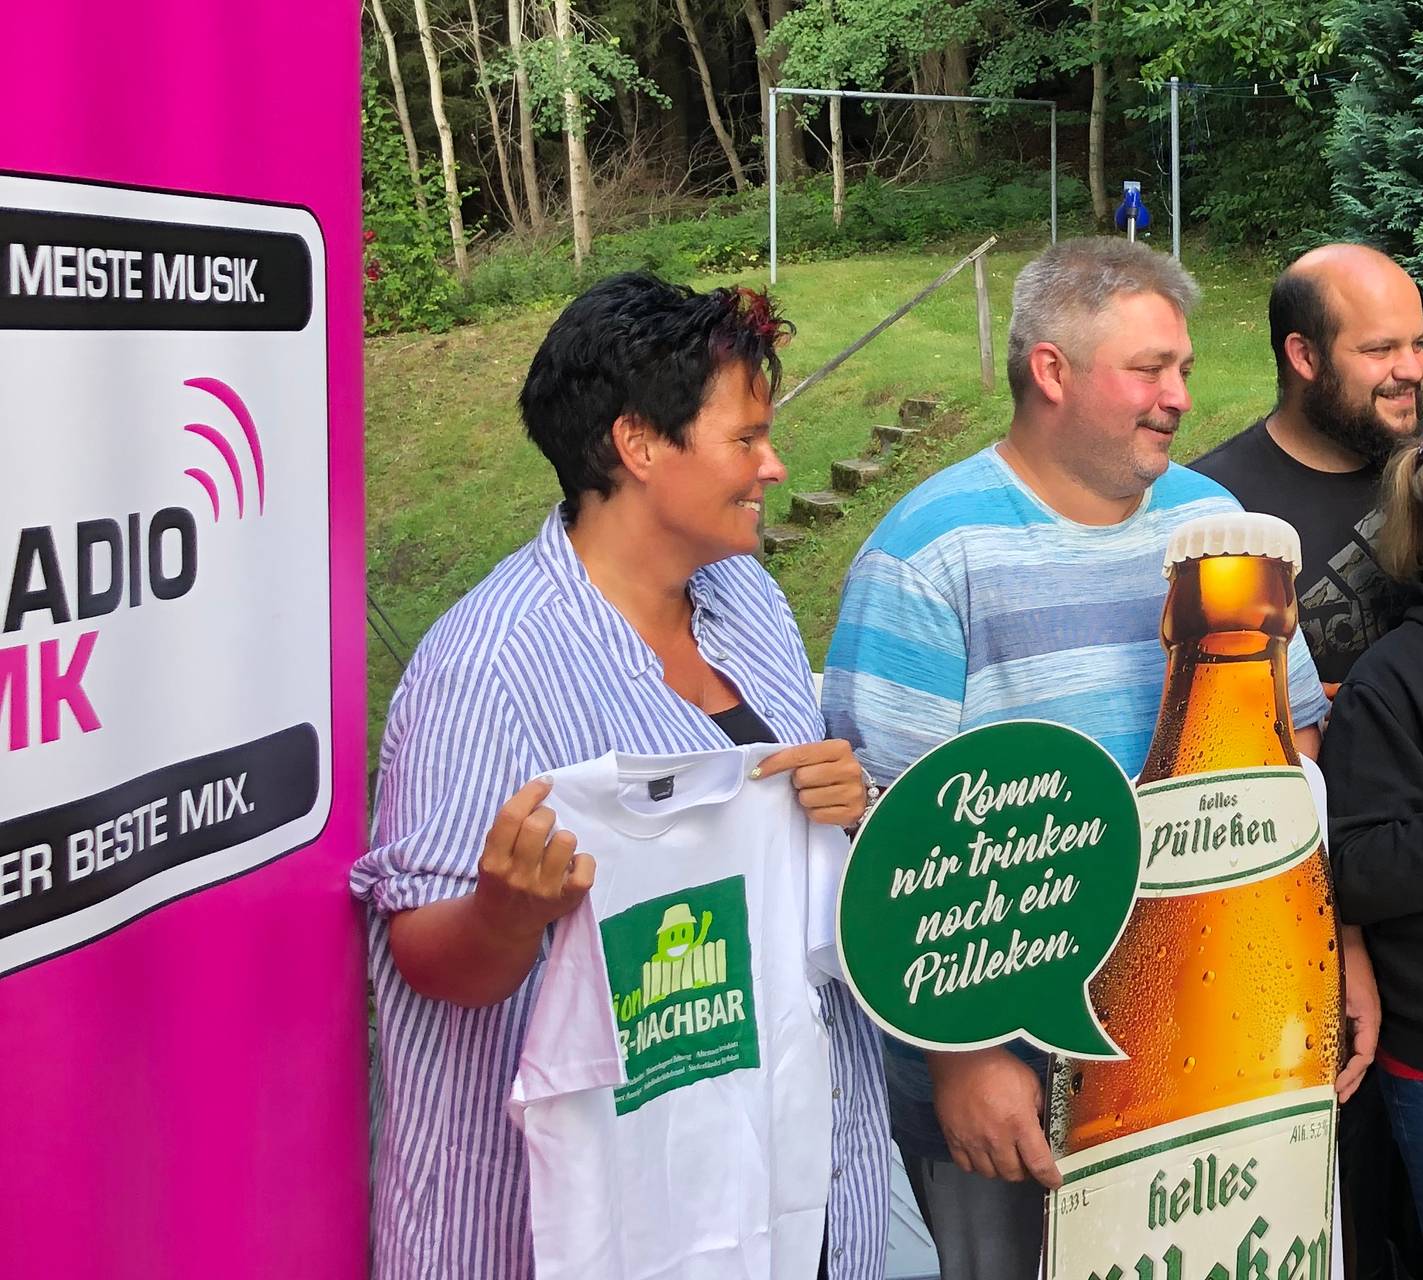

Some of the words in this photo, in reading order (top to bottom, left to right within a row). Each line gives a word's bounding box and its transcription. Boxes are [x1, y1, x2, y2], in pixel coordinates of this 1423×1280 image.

[9, 242, 144, 299] MEISTE
[152, 252, 266, 303] MUSIK.
[937, 768, 1072, 826] Komm,
[1198, 791, 1239, 812] helles
[0, 843, 53, 905] ER
[67, 797, 169, 883] BESTE
[178, 772, 256, 836] MIX.
[890, 845, 963, 899] wir
[967, 813, 1107, 877] trinken
[1145, 812, 1278, 869] Pülleken
[915, 879, 1014, 945] noch
[1019, 867, 1081, 914] ein
[903, 929, 1080, 1005] Pülleken.
[1060, 1192, 1080, 1215] 0,33
[1147, 1153, 1259, 1231] helles
